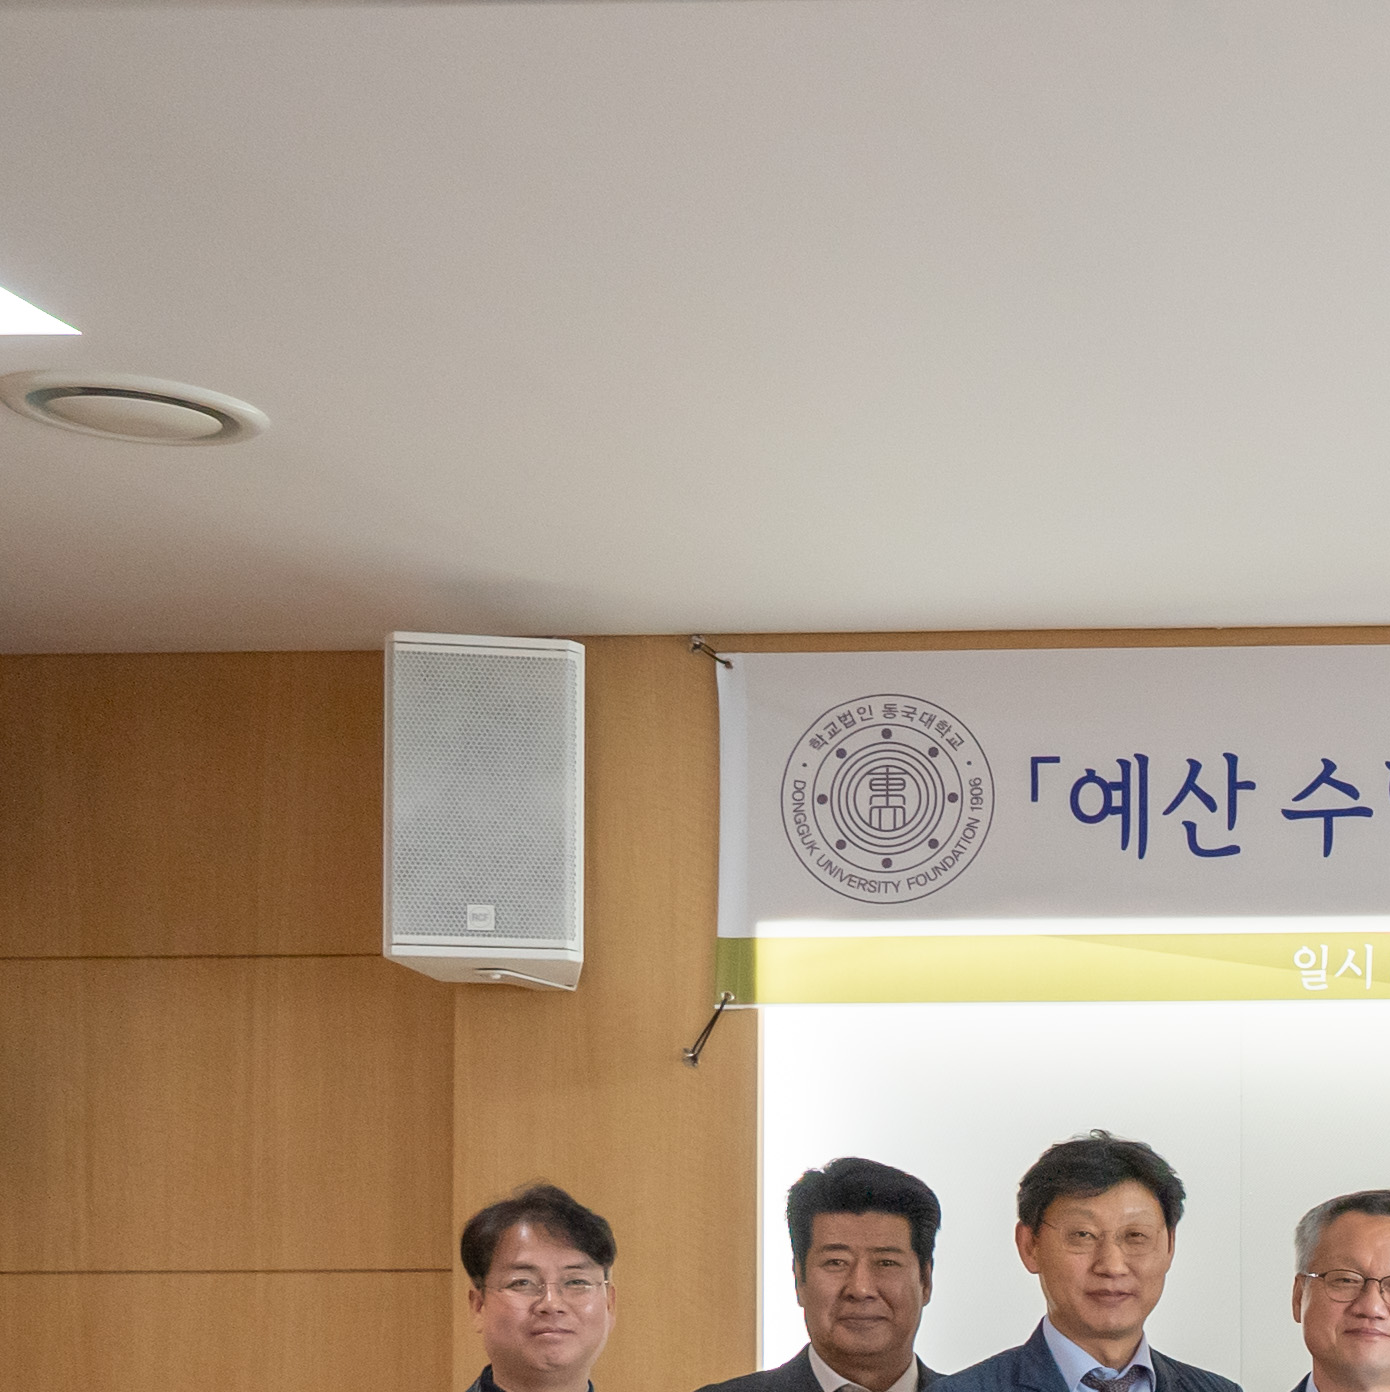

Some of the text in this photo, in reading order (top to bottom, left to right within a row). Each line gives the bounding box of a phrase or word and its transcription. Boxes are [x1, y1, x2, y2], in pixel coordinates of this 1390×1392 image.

[808, 703, 965, 751] 학교법인 동국대학교
[792, 777, 983, 894] DONGGUK UNIVERSITY FOUNDATION 1906
[1030, 752, 1257, 860] 「예산
[1293, 943, 1374, 990] 일시
